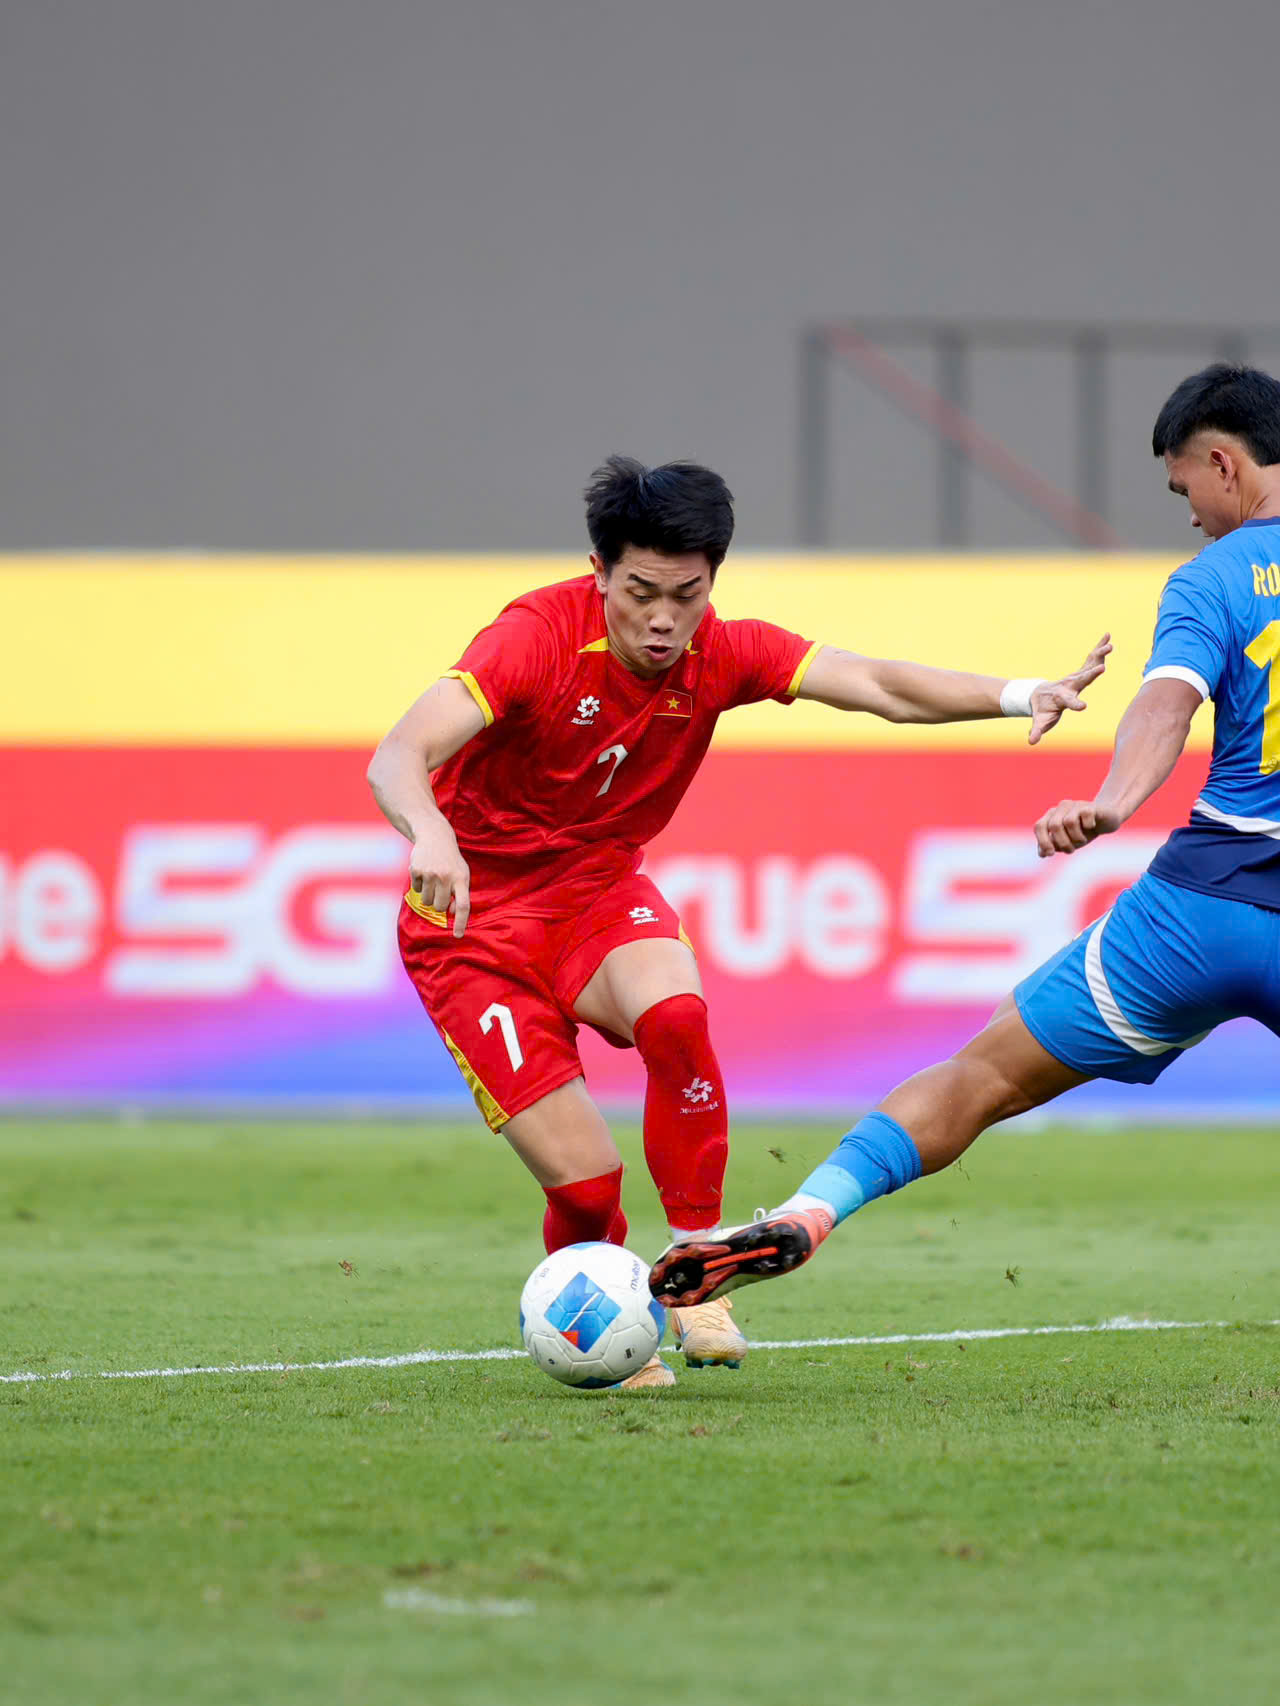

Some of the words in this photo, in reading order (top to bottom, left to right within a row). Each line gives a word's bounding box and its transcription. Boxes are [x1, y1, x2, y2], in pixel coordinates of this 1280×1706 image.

[595, 744, 628, 798] 7
[105, 824, 403, 998] 5G
[478, 1002, 524, 1073] 7
